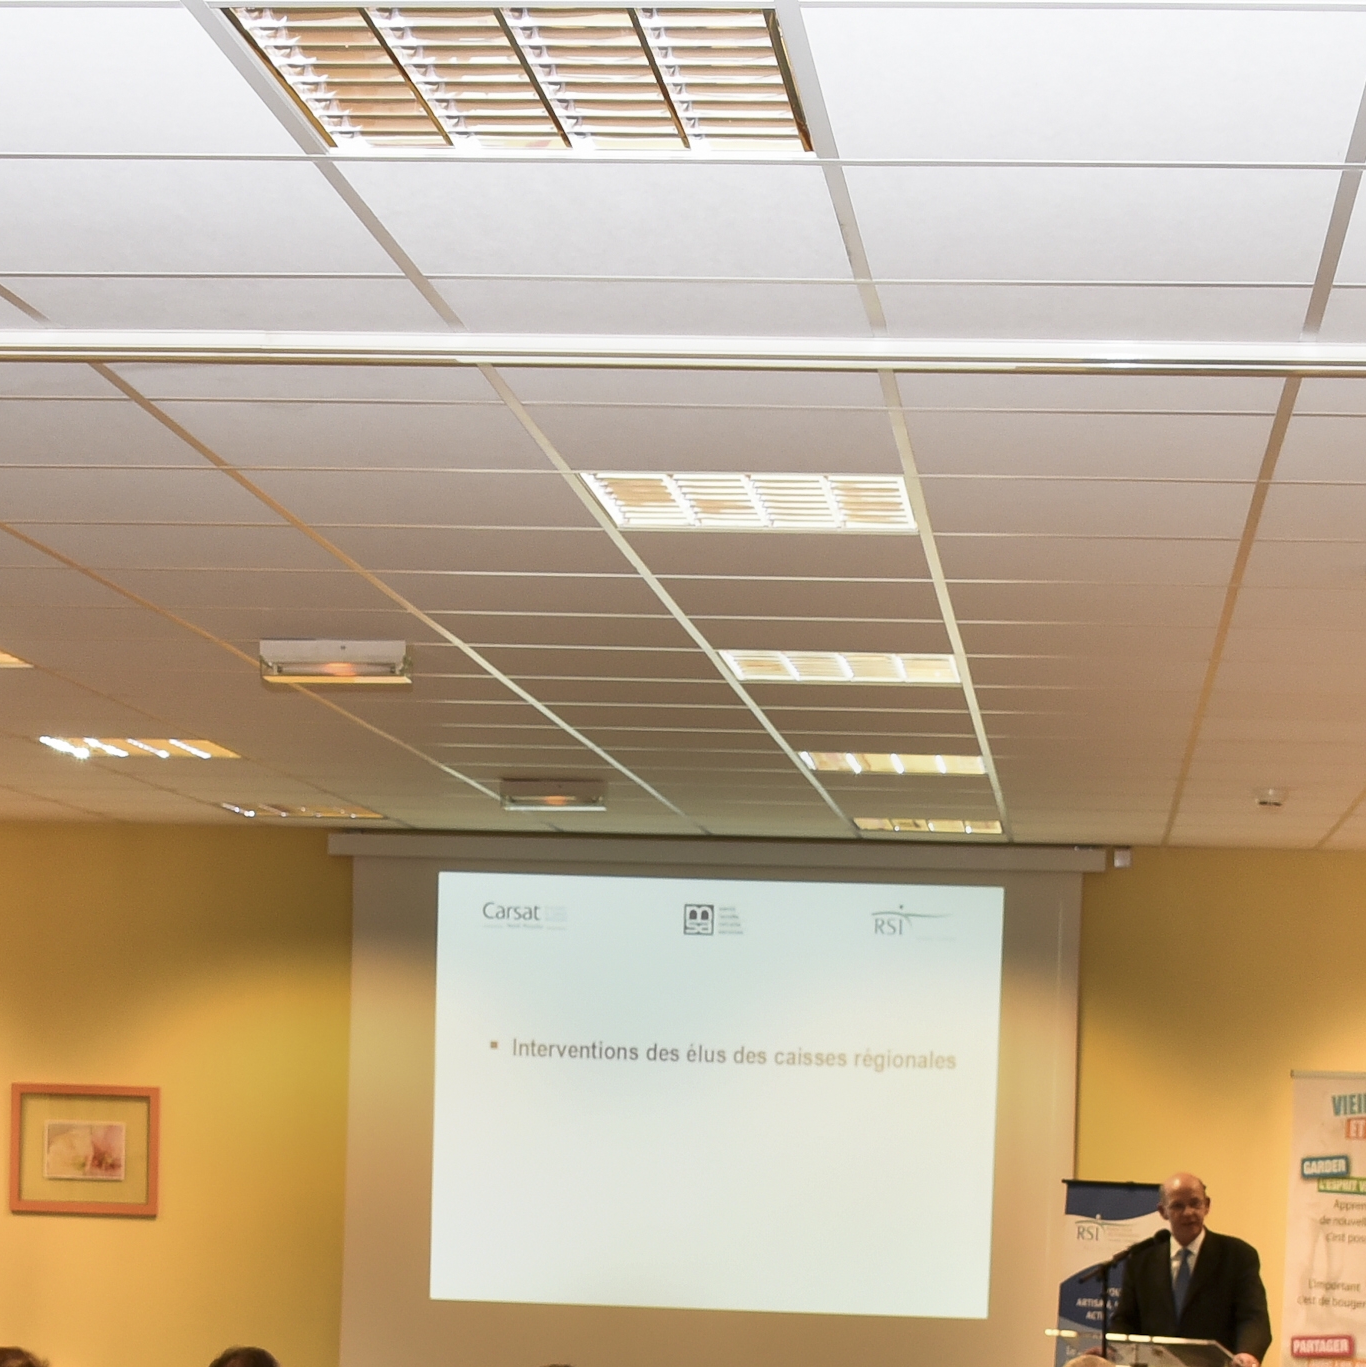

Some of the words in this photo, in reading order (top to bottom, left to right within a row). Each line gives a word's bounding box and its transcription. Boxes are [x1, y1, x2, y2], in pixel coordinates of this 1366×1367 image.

[483, 902, 541, 921] Carsat
[874, 917, 903, 935] RSI
[512, 1037, 639, 1061] Interventions
[646, 1042, 680, 1062] des
[686, 1042, 726, 1064] élus
[733, 1045, 767, 1065] des
[774, 1048, 847, 1067] caisses
[854, 1048, 956, 1073] régionales
[1350, 1119, 1366, 1138] ET
[1303, 1158, 1347, 1176] GARDER
[1319, 1216, 1331, 1225] de
[1077, 1225, 1099, 1241] RSI
[1293, 1339, 1349, 1354] PARTAGER
